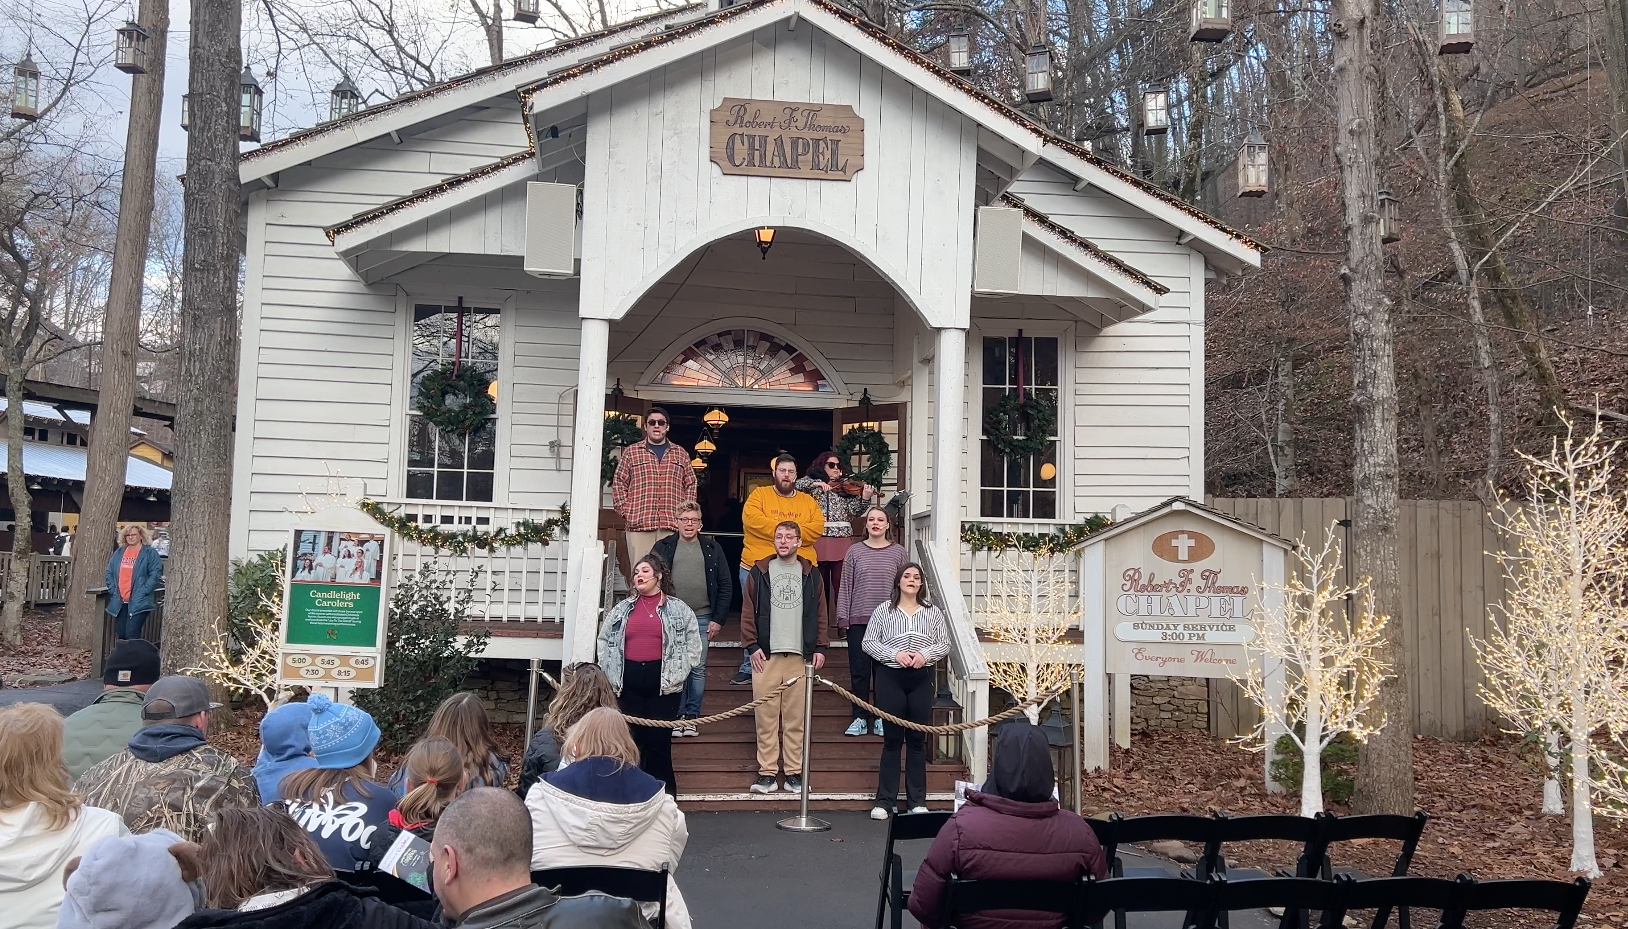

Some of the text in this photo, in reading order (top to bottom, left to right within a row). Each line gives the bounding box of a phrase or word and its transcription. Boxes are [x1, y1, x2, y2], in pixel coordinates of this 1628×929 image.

[726, 103, 778, 129] Robert
[796, 107, 850, 133] Thomas
[725, 132, 849, 175] CHAPEL
[1121, 567, 1175, 594] Robert
[1196, 568, 1249, 596] Thomas
[309, 590, 361, 600] Candlelight
[315, 599, 354, 608] Carolers
[1116, 593, 1254, 620] CHAPEL
[1132, 622, 1236, 632] SUNDAY SERVICE
[1161, 631, 1206, 641] 3:00 PM
[1131, 647, 1237, 668] Everyone Welcome
